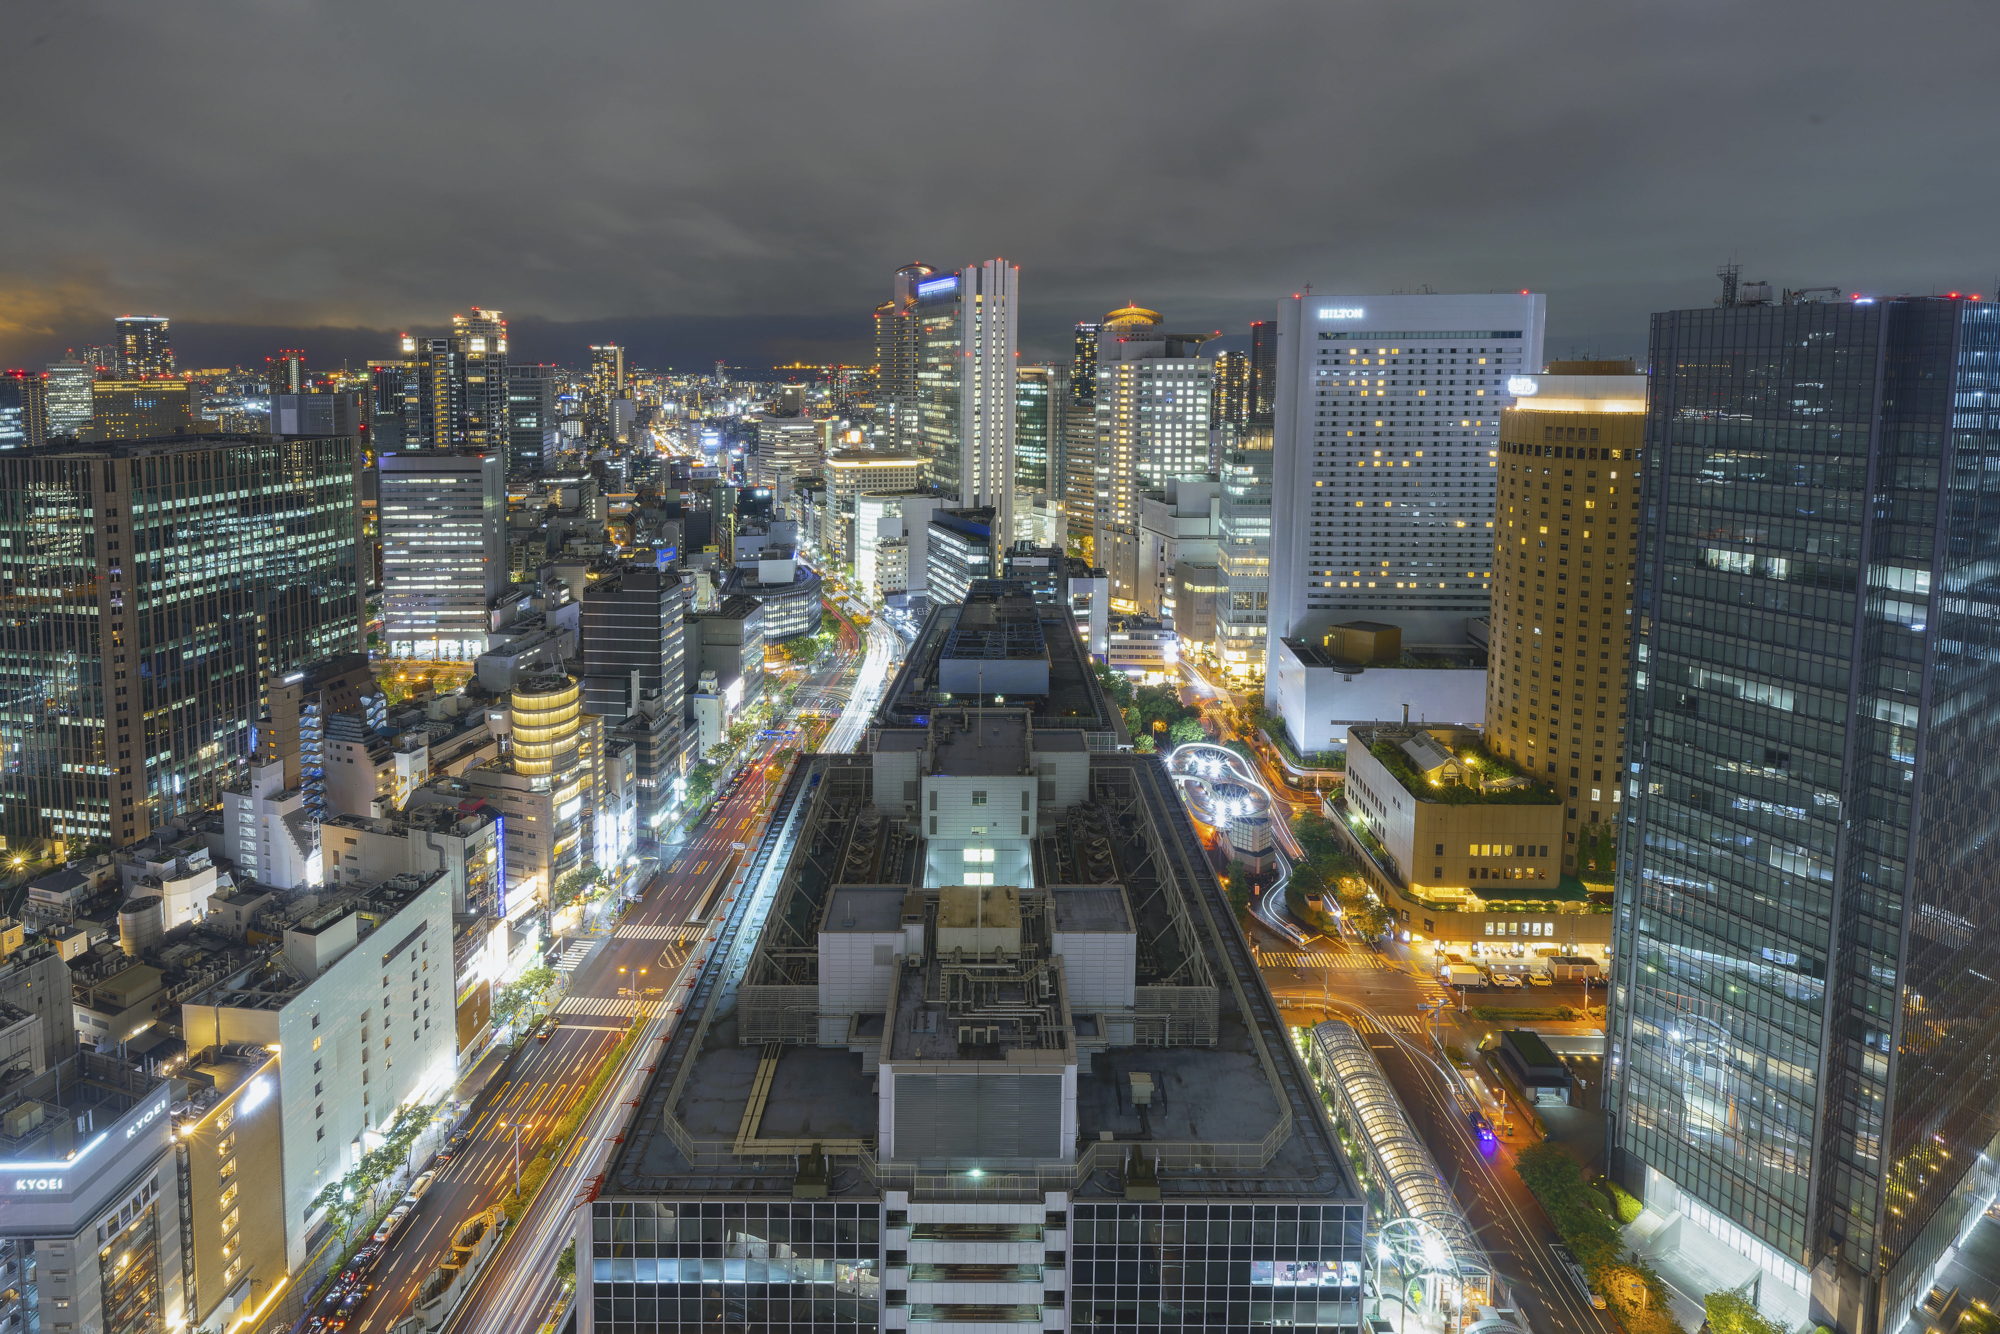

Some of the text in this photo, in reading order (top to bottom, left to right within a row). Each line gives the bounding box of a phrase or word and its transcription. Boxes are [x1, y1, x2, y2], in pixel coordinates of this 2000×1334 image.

[1320, 309, 1363, 319] HILTON
[126, 1099, 166, 1139] KYOEI
[16, 1178, 63, 1191] KYOEI
